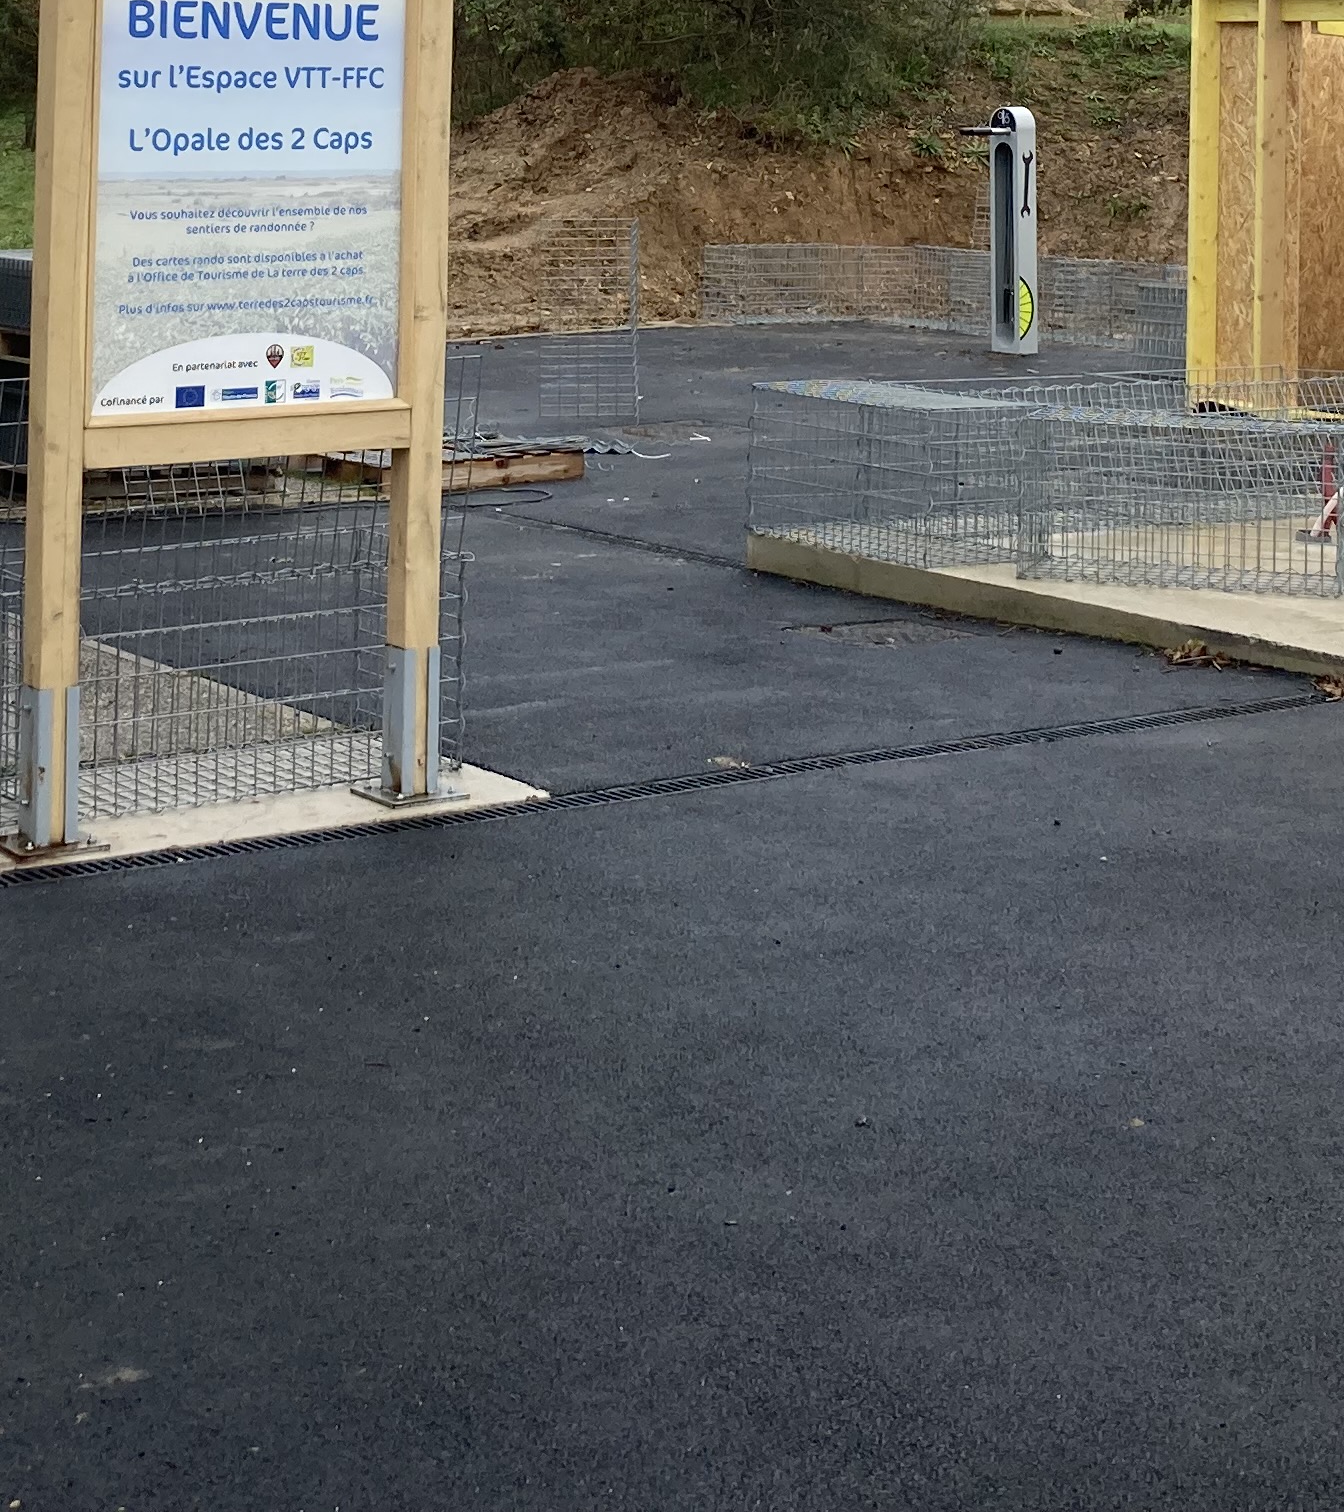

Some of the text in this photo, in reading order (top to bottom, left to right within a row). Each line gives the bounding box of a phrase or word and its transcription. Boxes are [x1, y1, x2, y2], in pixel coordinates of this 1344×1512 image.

[128, 0, 379, 41] BIENVENUE
[118, 64, 385, 94] sur l'Espace VTT-FFC
[129, 126, 373, 156] L'Opale des 2 Caps
[129, 210, 158, 220] Vous
[160, 209, 215, 220] souhaitez
[217, 207, 269, 219] découvrir
[333, 205, 346, 216] de
[348, 205, 368, 216] nos
[185, 221, 316, 235] sentiers de randonnée ?
[132, 256, 154, 268] Des
[155, 255, 190, 267] cartes
[192, 254, 225, 266] rando
[227, 253, 252, 265] sont
[253, 251, 318, 264] disponibles
[180, 270, 195, 282] de
[198, 269, 249, 281] Tourisme
[251, 268, 265, 279] de
[267, 267, 279, 278] La
[281, 266, 308, 278] terre
[309, 265, 329, 277] des
[331, 266, 338, 276] 2
[118, 304, 143, 315] Plus
[186, 302, 205, 313] sur
[172, 360, 259, 373] En partenariat avec
[100, 395, 165, 407] Cofinancé par
